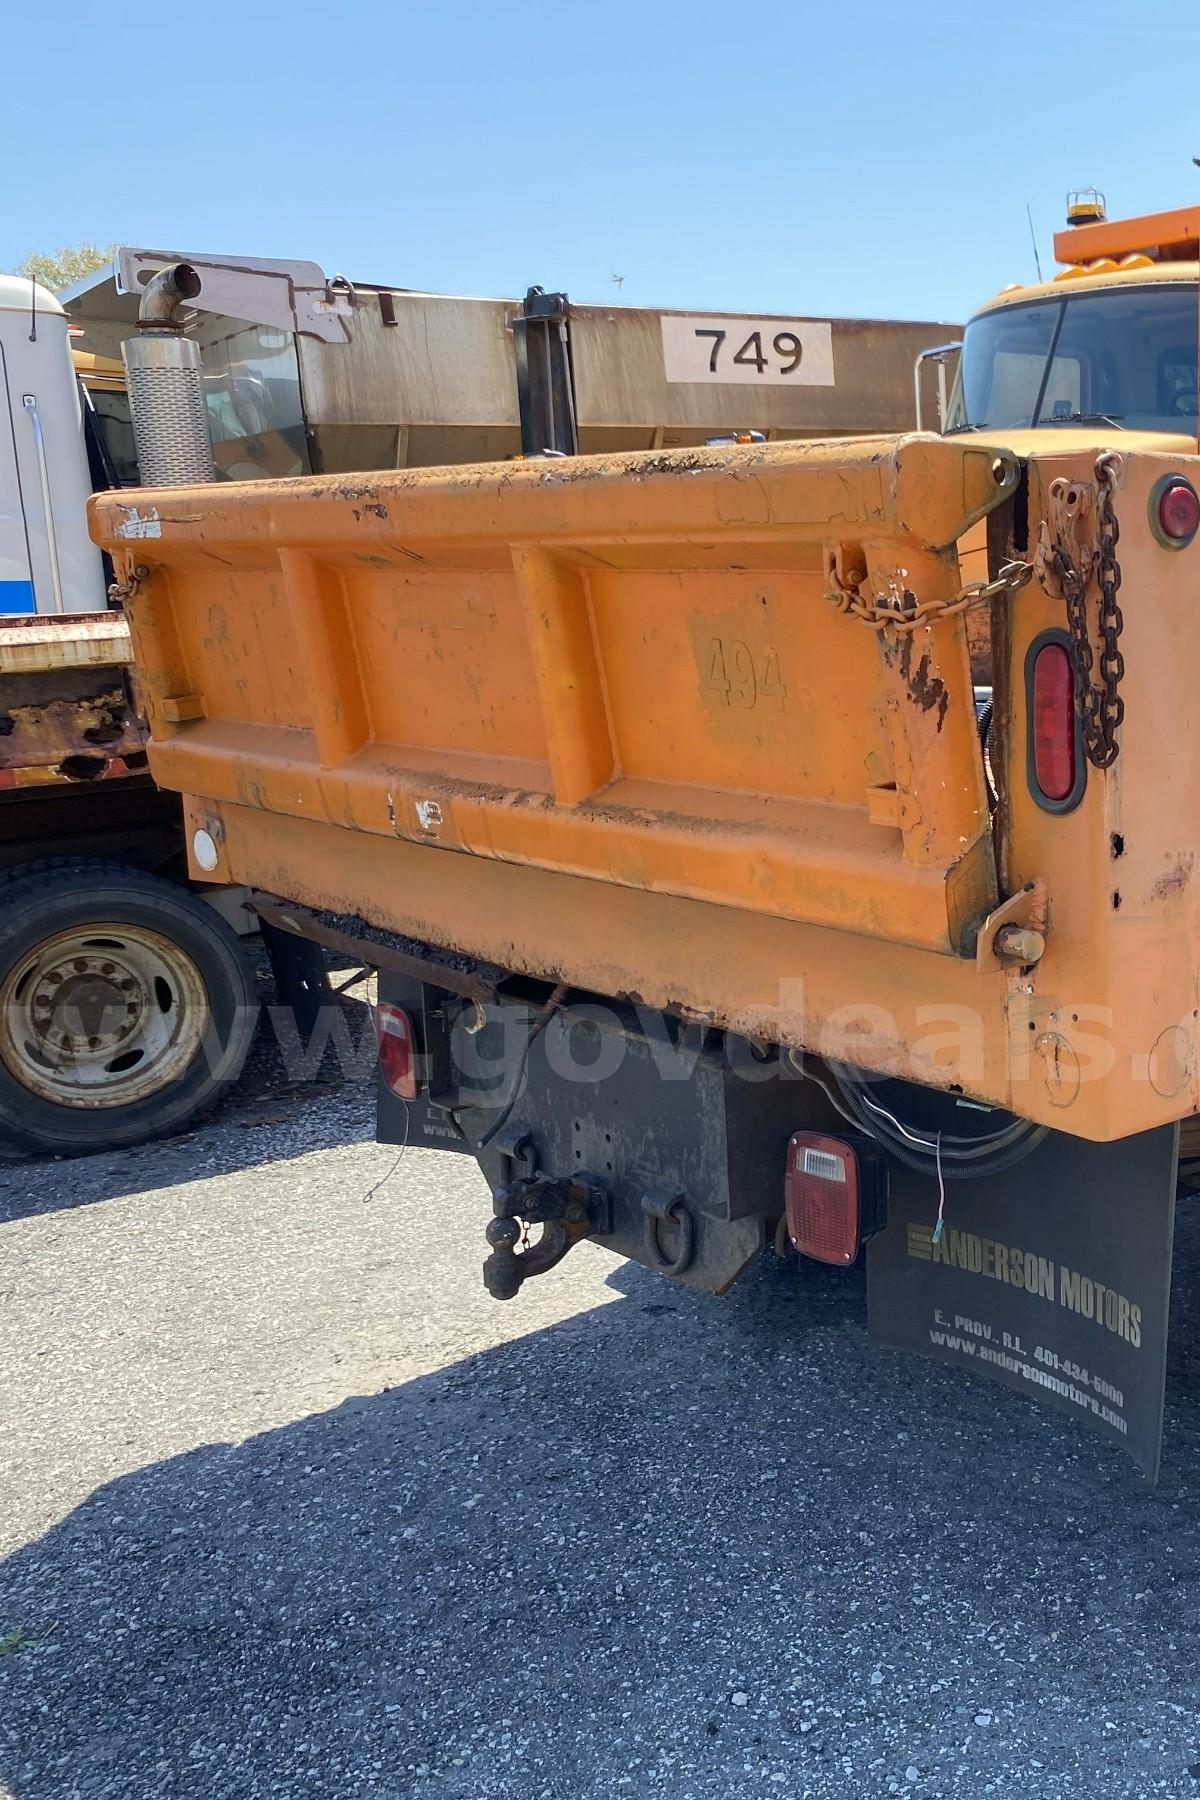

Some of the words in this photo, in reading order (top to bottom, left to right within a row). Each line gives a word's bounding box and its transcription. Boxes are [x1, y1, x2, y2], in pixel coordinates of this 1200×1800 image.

[694, 329, 803, 375] 749
[932, 1228, 1055, 1301] ANDERSON
[1060, 1265, 1142, 1349] MOTORS
[929, 1329, 1128, 1435] www.andersonmotors.com
